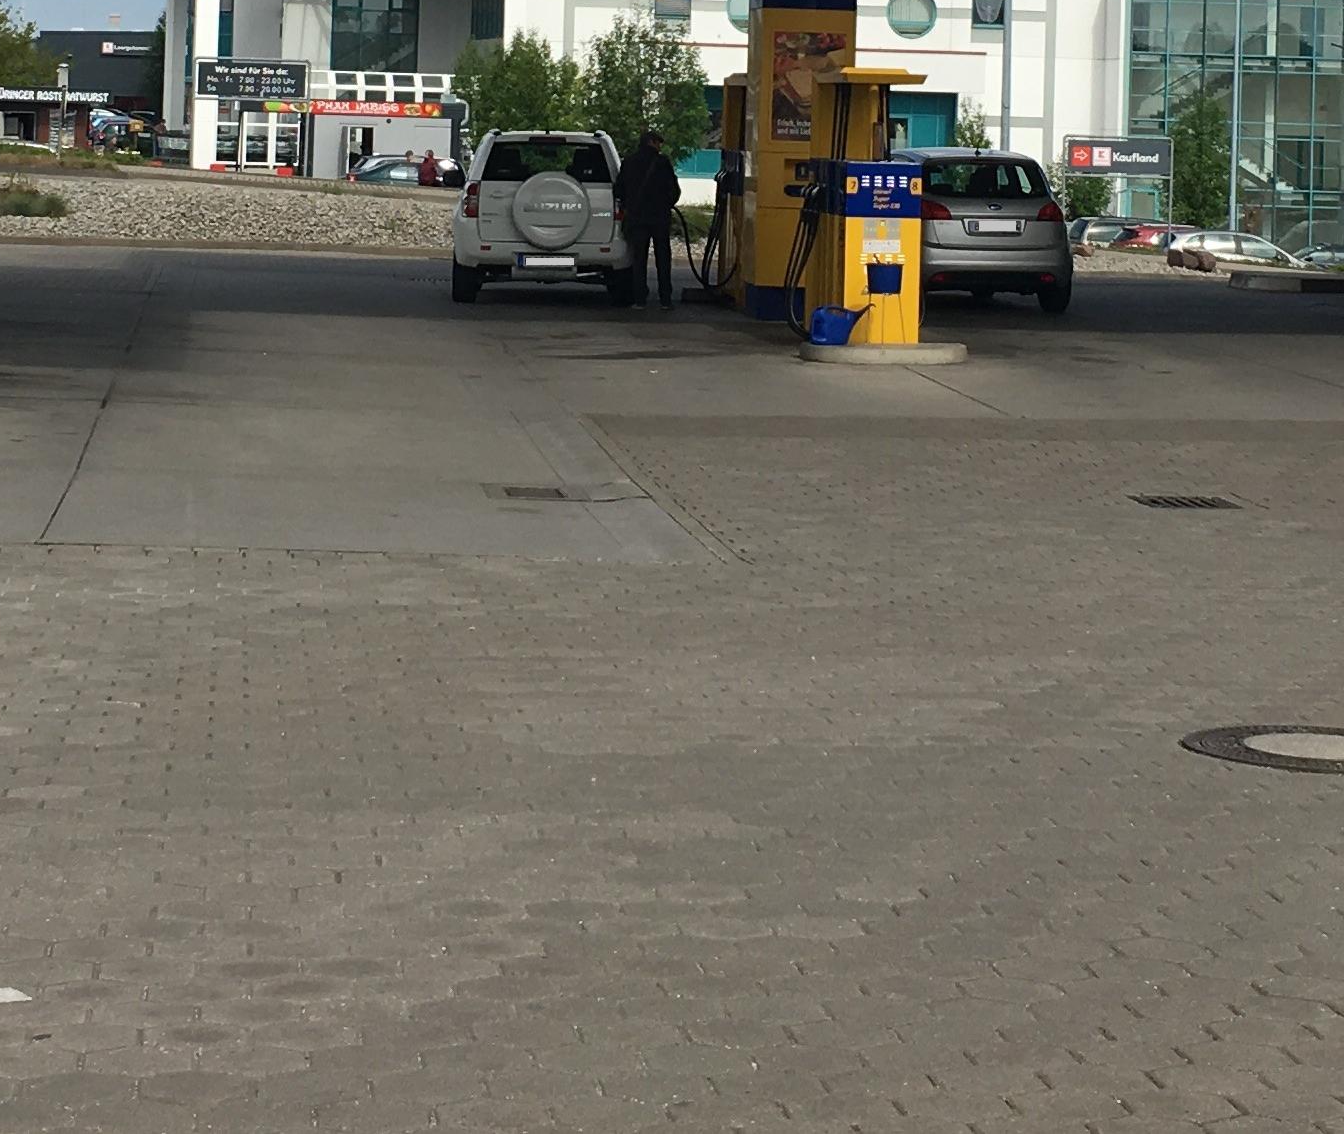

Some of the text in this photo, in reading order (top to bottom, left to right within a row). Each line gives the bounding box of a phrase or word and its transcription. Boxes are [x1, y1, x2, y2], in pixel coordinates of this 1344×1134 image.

[214, 65, 229, 74] Wir
[230, 66, 248, 74] sind
[248, 66, 261, 75] für
[262, 67, 275, 75] Sie
[283, 77, 297, 85] Uhr
[1112, 151, 1160, 164] Kaufland
[850, 180, 856, 190] 7
[911, 181, 918, 191] 8
